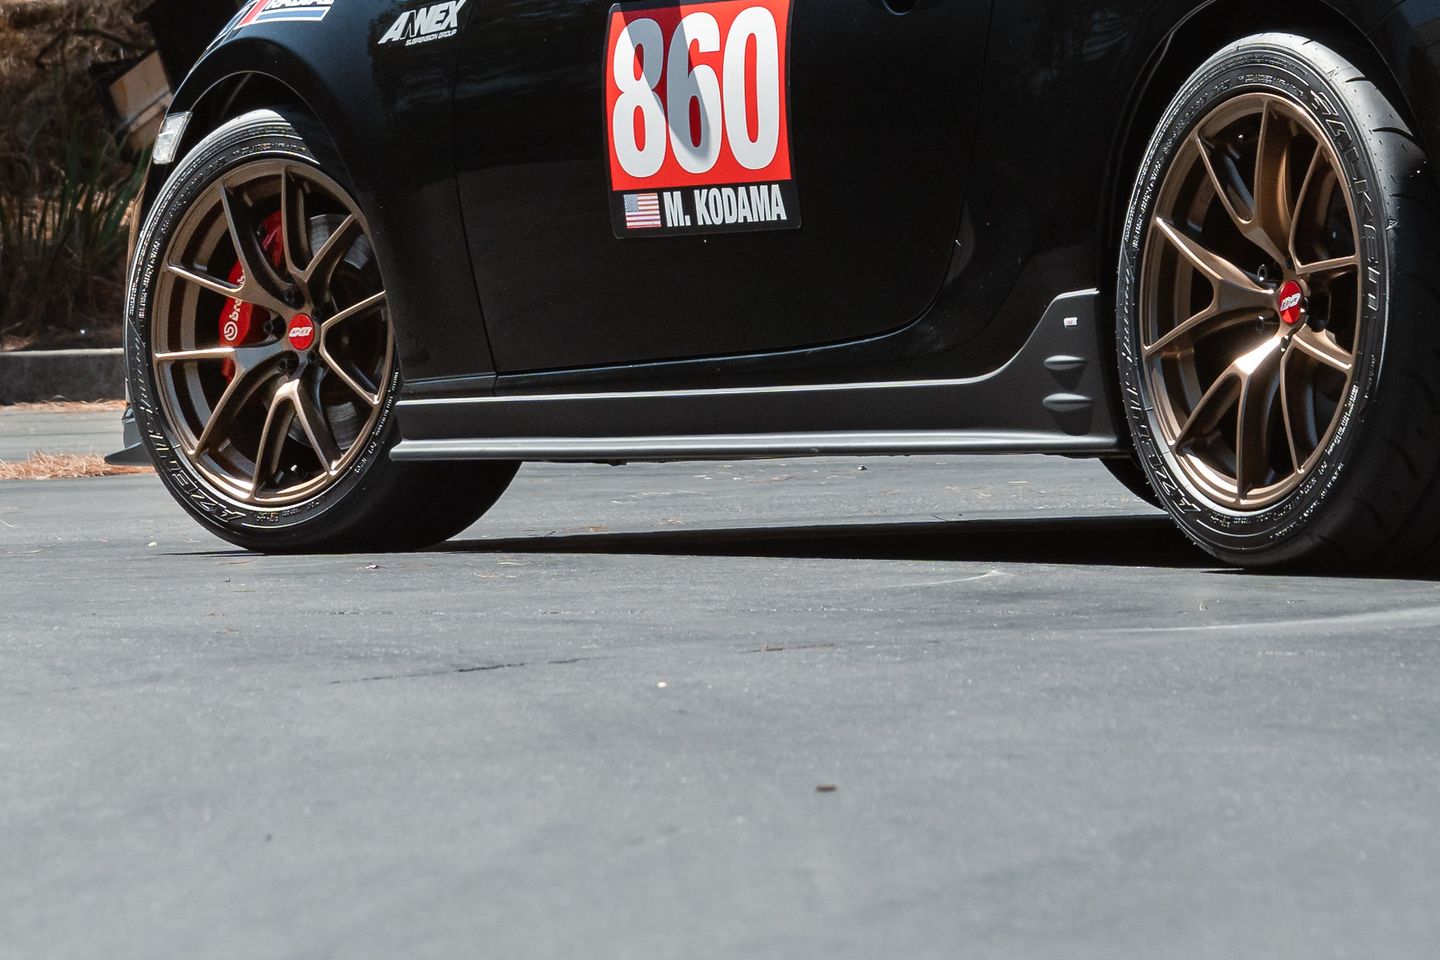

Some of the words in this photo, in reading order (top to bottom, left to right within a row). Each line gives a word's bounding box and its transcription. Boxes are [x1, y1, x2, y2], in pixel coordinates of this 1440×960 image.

[612, 6, 780, 178] 860
[662, 191, 691, 228] M.
[694, 184, 788, 227] KODAMA
